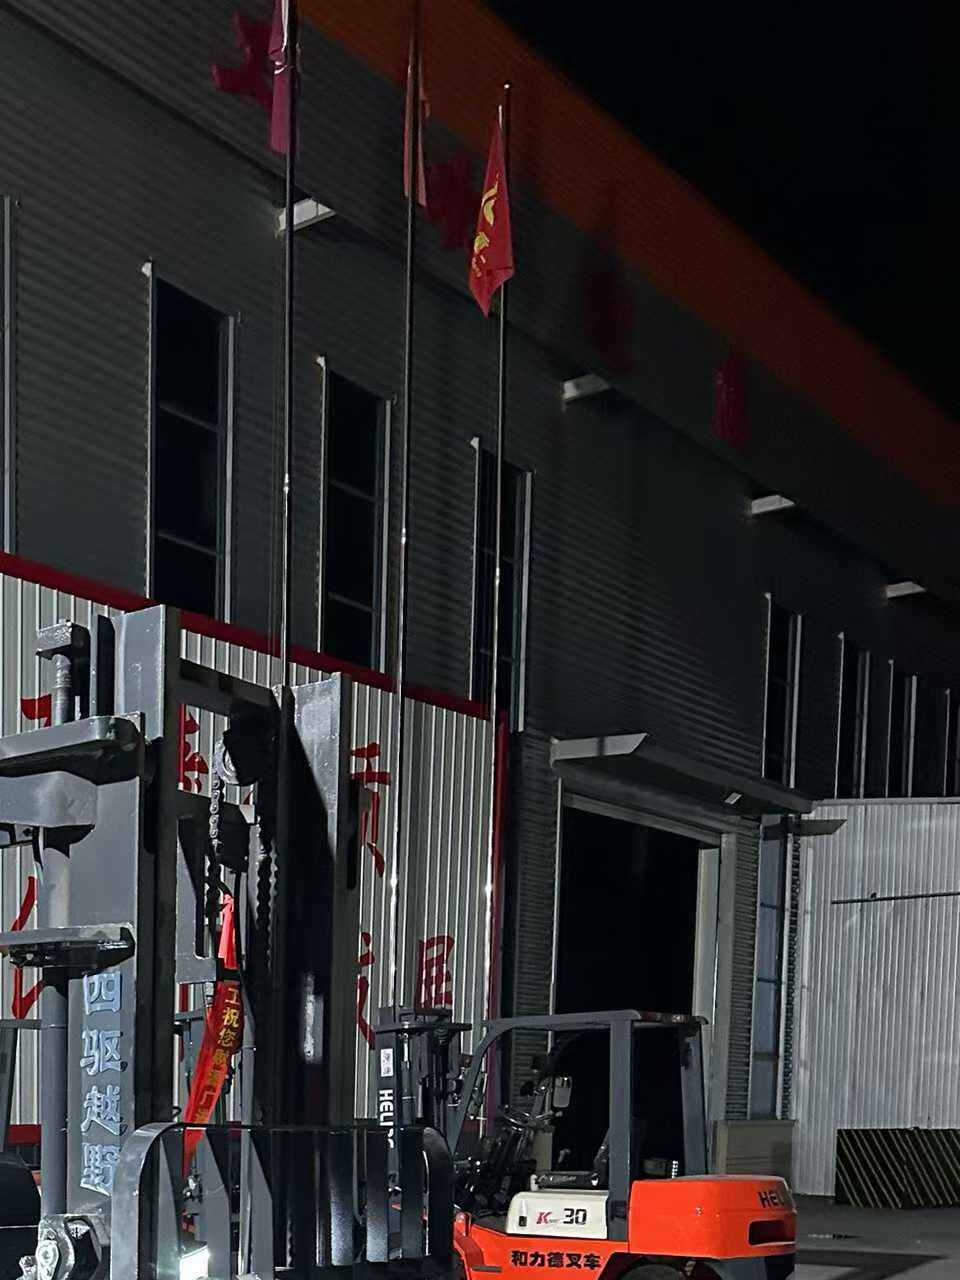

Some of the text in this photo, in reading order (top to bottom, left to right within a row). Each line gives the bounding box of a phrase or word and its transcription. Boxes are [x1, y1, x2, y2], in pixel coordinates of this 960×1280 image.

[79, 971, 123, 1197] 四驱越野
[563, 1207, 588, 1225] 30
[511, 1250, 601, 1270] 和力德叉车
